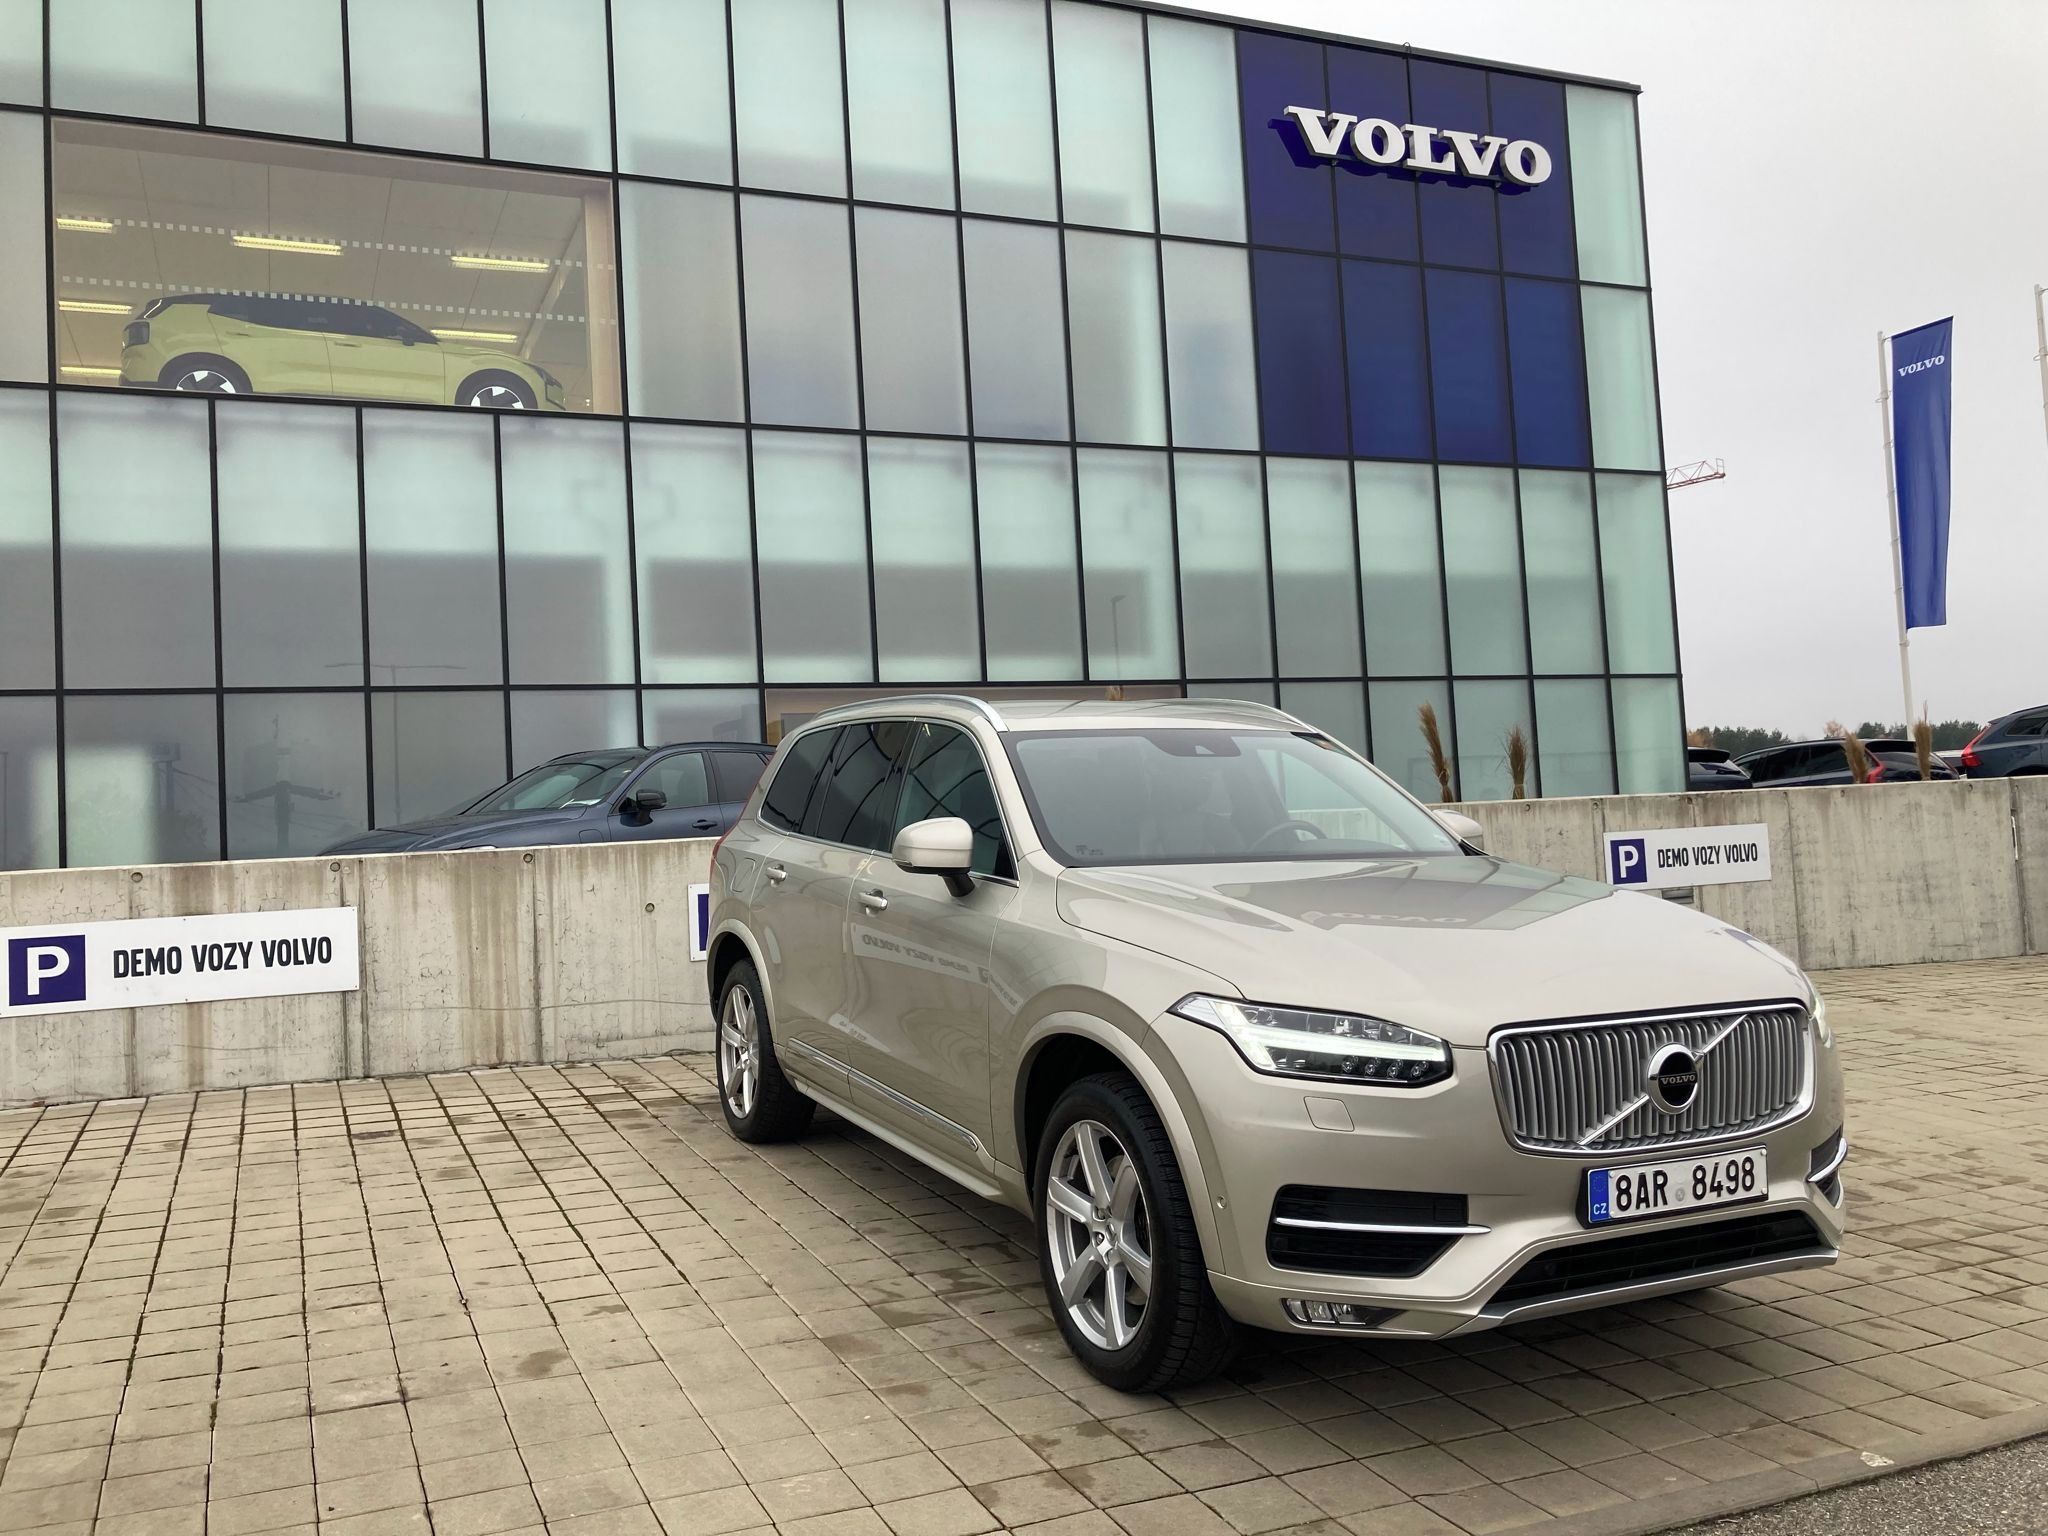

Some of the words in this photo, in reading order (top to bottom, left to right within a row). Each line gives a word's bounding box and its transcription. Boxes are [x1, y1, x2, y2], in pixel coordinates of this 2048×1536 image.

[1283, 105, 1553, 186] VOLVO
[1898, 355, 1945, 377] VOLVO
[1618, 845, 1639, 879] P
[1657, 848, 1689, 869] DEMO
[1692, 845, 1721, 866] VOZY
[1724, 842, 1758, 864] VOLVO
[27, 945, 70, 996] P
[113, 946, 182, 979] DEMO
[191, 941, 253, 973] VOZY
[260, 936, 332, 968] VOLVO
[1661, 1074, 1695, 1085] VOLVO
[1615, 1169, 1669, 1212] 8AR
[1692, 1156, 1755, 1201] 8498
[1593, 1203, 1607, 1215] CZ
